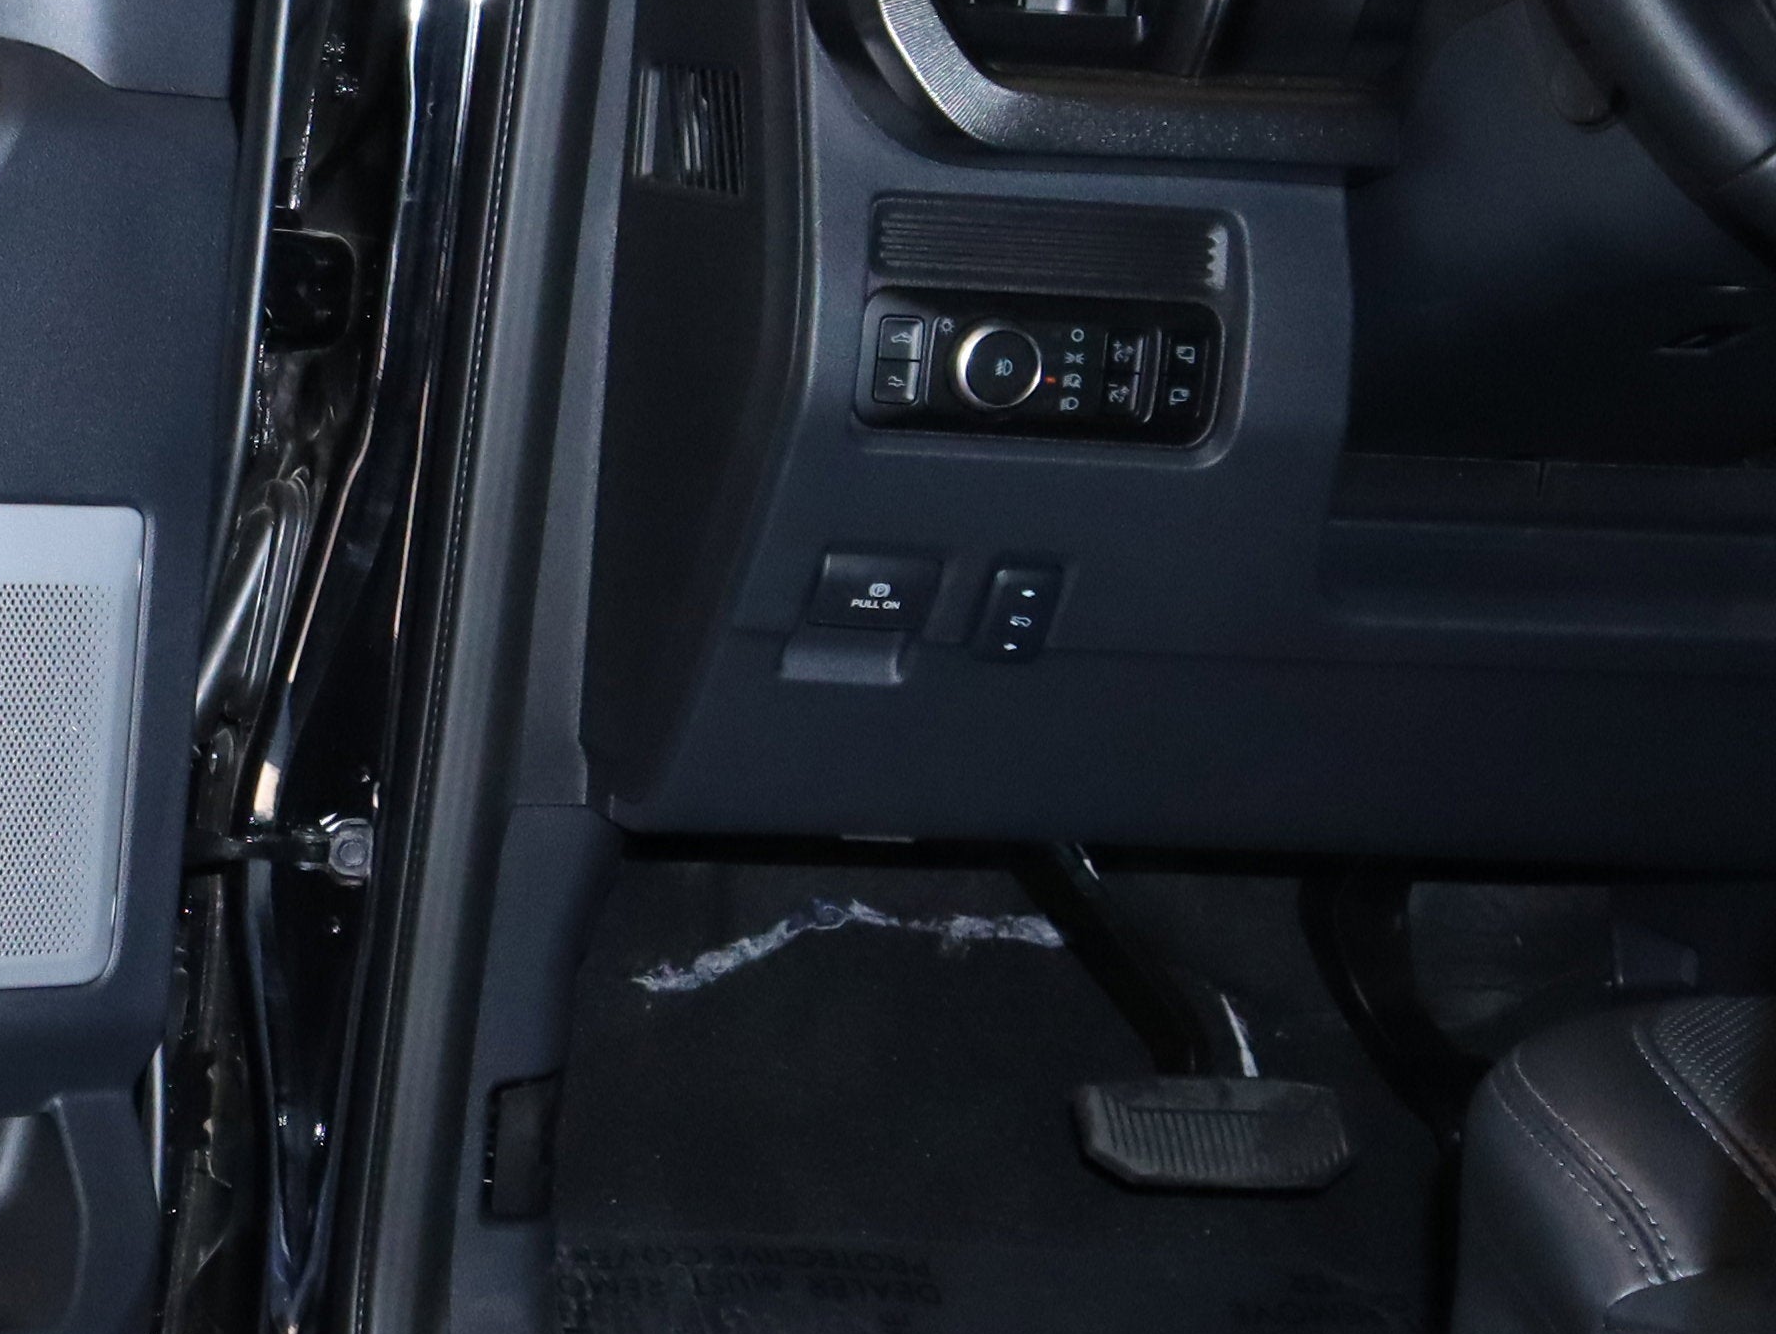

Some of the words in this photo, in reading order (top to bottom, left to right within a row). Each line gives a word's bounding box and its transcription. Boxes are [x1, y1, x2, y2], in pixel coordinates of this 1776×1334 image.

[850, 598, 880, 609] PULL
[882, 600, 900, 610] ON
[708, 1243, 931, 1277] PROTECTIVE
[806, 1274, 942, 1305] DEALER
